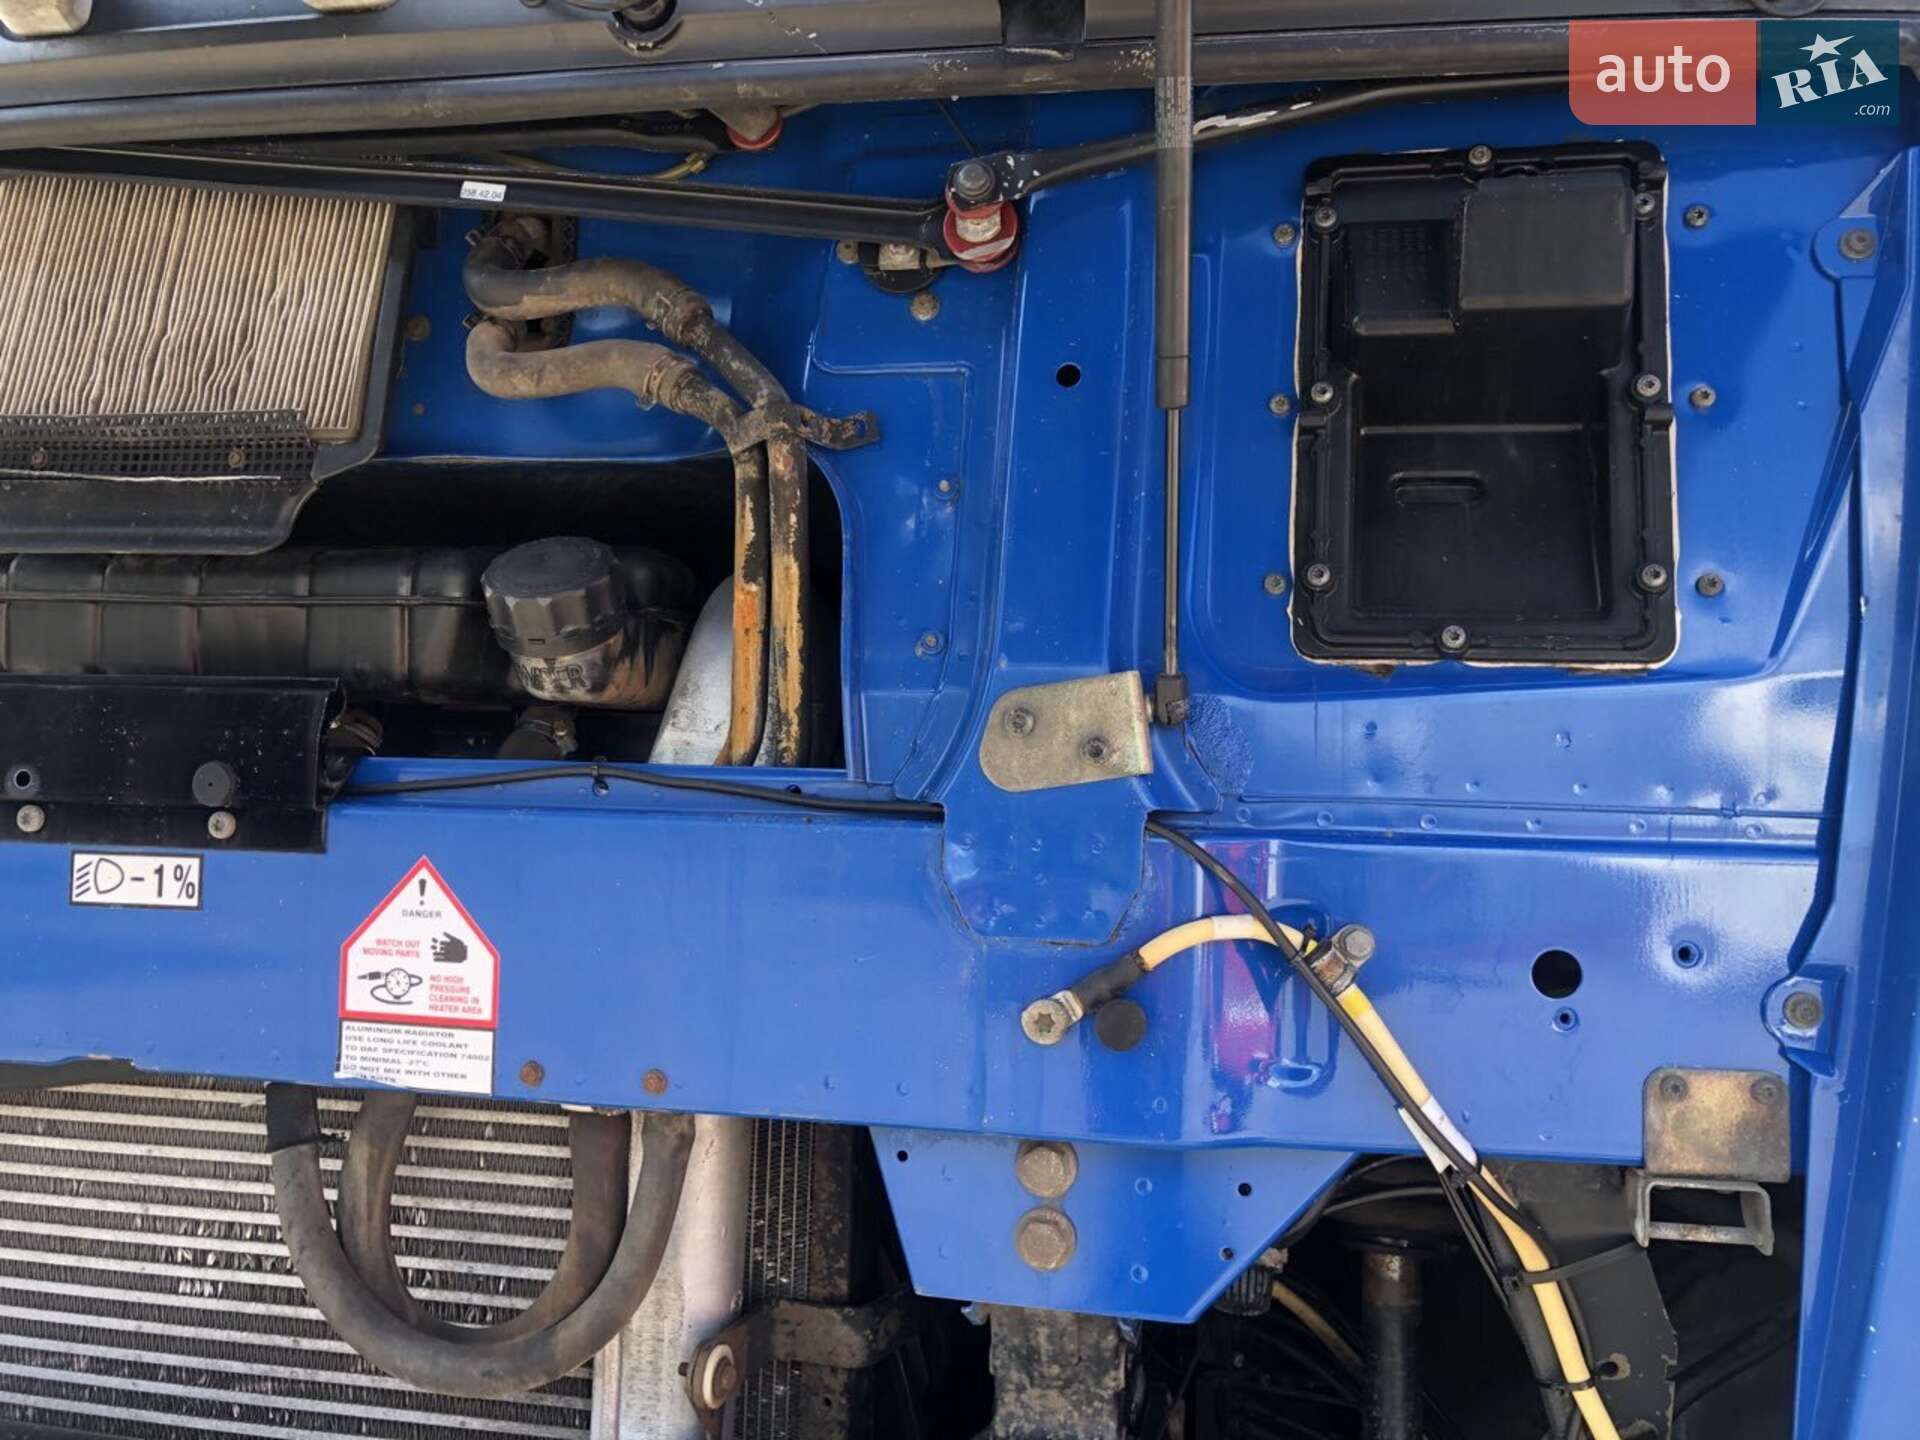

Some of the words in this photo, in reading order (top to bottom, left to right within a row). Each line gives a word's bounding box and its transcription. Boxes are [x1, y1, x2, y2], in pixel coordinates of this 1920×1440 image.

[401, 909, 442, 919] DANGER
[375, 938, 403, 947] WATCH
[405, 939, 421, 948] OUT
[363, 947, 394, 957] MOVING
[395, 949, 421, 958] PARTS
[429, 974, 442, 983] NO
[444, 975, 464, 984] HIGH
[429, 984, 471, 994] PRESSURE
[428, 994, 469, 1004] CLEANING
[471, 996, 480, 1004] IN
[428, 1004, 460, 1013] HEATER
[461, 1006, 483, 1014] AREA
[345, 1025, 402, 1035] ALUMINIUM
[404, 1029, 456, 1038] RADIATOR
[345, 1035, 364, 1043] USE
[366, 1036, 395, 1045] LONG
[397, 1038, 418, 1046] LIFE
[420, 1040, 470, 1049] COOLANT
[345, 1044, 358, 1052] TO
[360, 1045, 378, 1053] DAF
[382, 1047, 458, 1059] SPECIFICATION
[345, 1054, 358, 1062] TO
[360, 1056, 402, 1065] MINIMAL
[360, 1065, 380, 1073] NOT
[383, 1067, 401, 1075] MIX
[404, 1069, 431, 1078] WITH
[433, 1071, 468, 1080] OTHER
